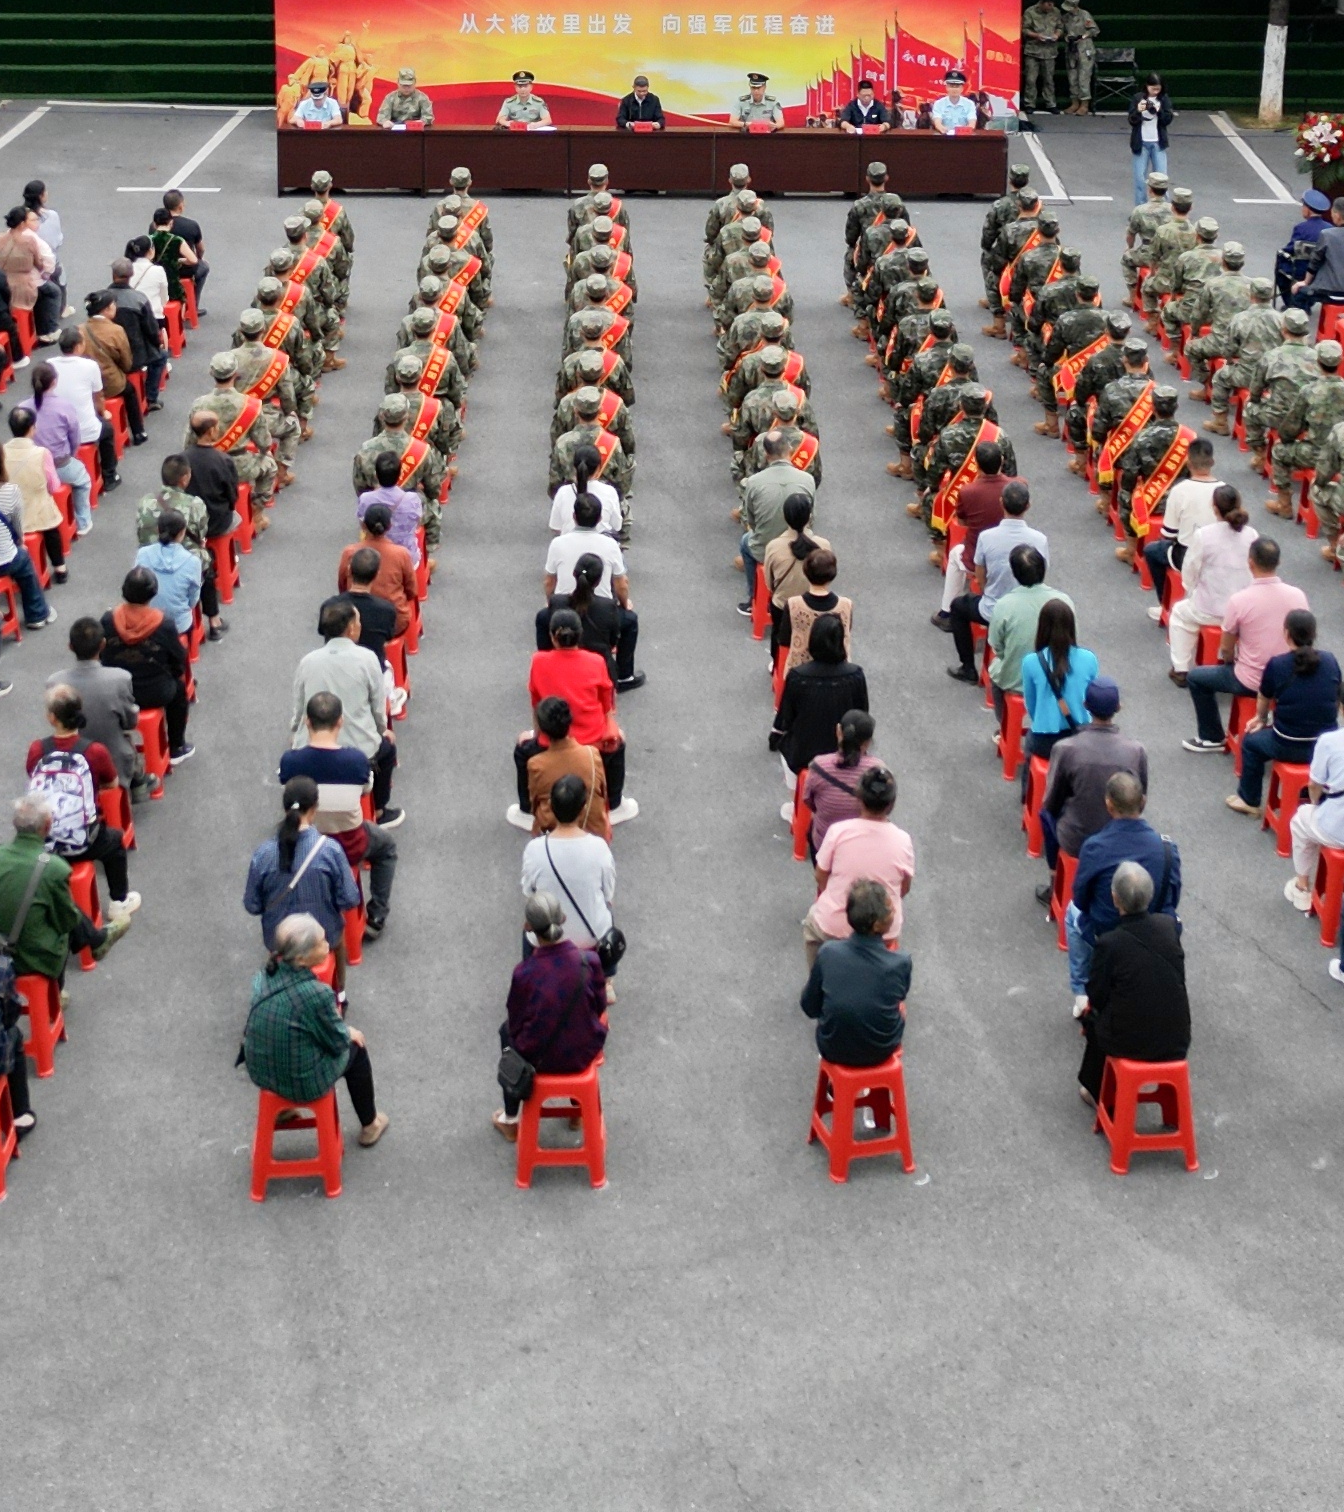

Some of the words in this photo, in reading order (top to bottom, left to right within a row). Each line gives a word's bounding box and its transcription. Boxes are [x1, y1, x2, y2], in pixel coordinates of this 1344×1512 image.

[459, 13, 633, 35] 从大将故里出发
[661, 14, 836, 36] 向强军征程奋进
